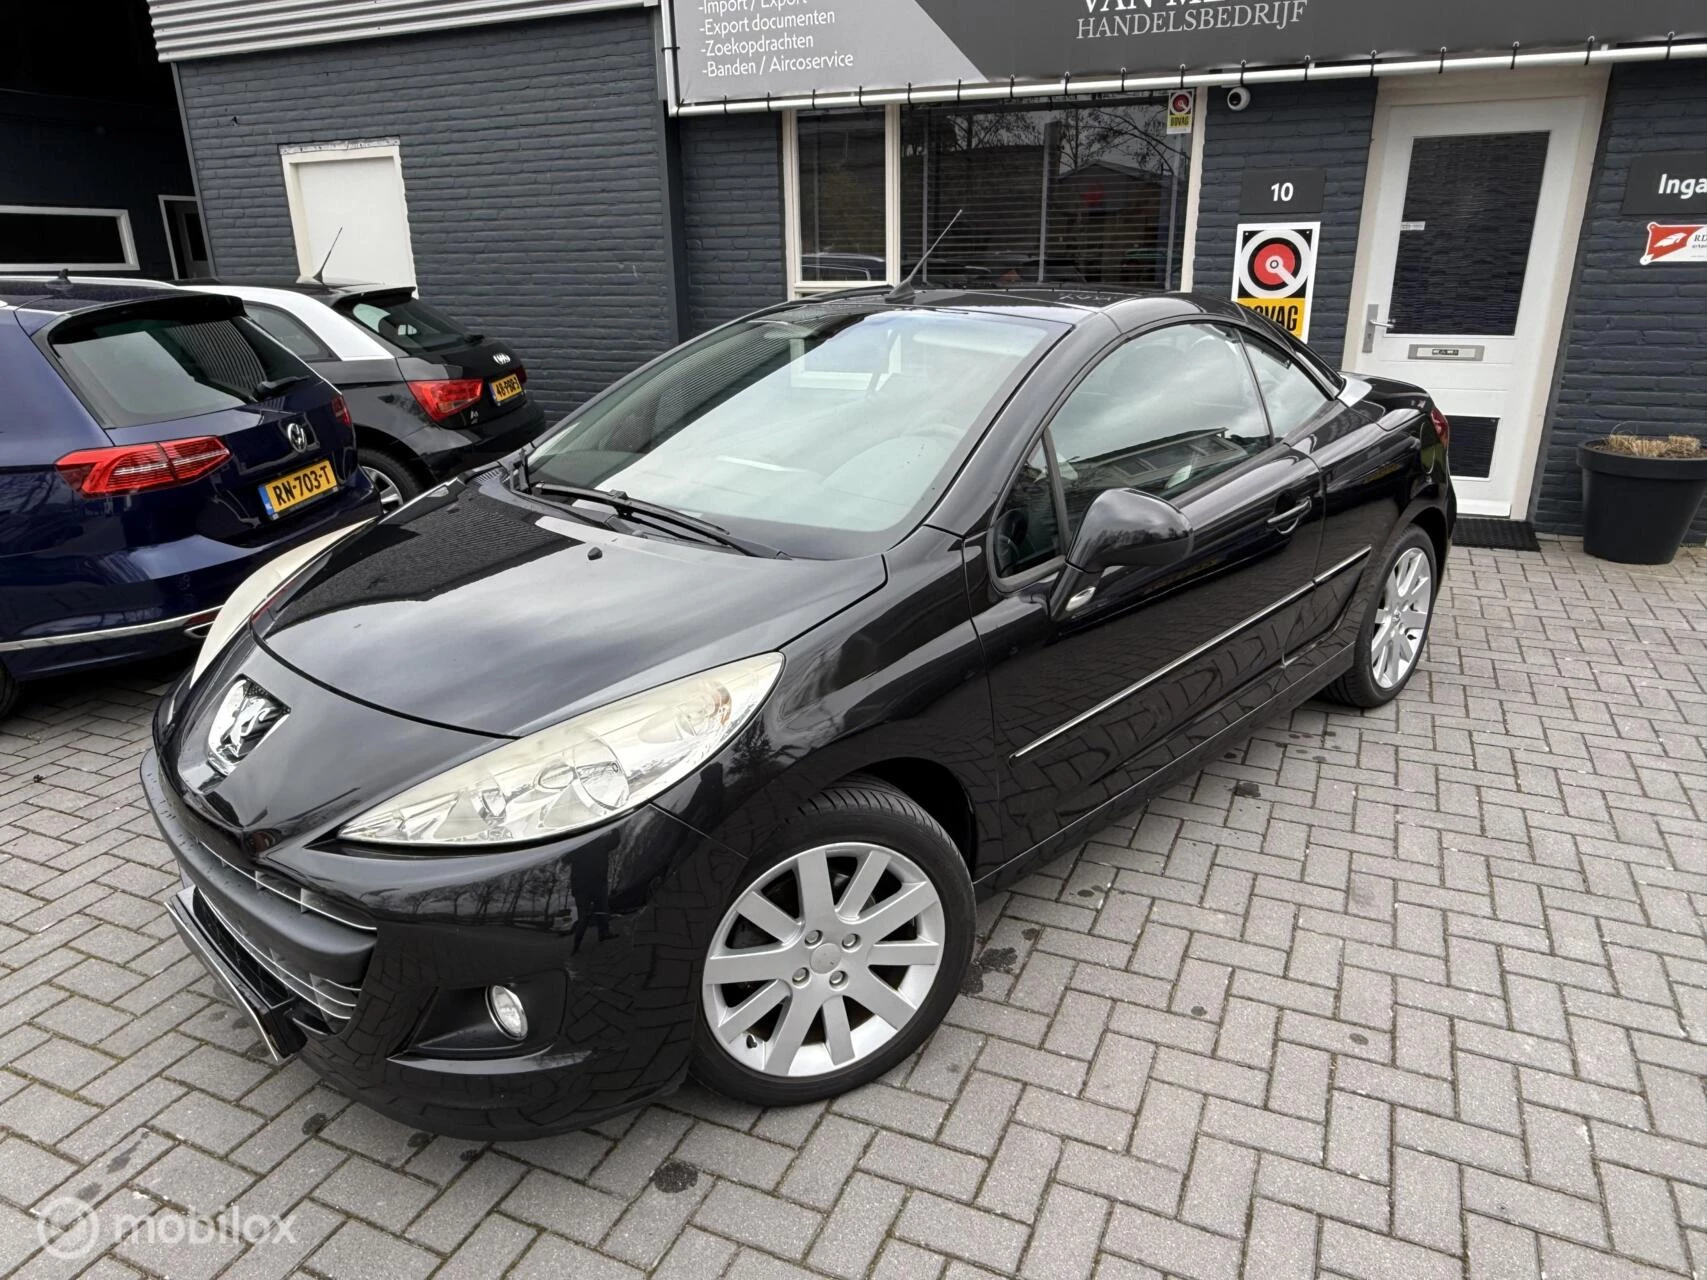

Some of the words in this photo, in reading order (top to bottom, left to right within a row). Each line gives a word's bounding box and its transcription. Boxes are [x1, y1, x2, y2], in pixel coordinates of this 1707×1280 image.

[761, 0, 807, 11] Expo
[699, 17, 750, 38] -Export
[752, 11, 834, 31] documenten
[1076, 0, 1308, 39] HANDELSBEDRIJF
[700, 32, 814, 57] -Zoekopdrachten
[702, 58, 756, 77] -Banden
[769, 50, 854, 73] Aircoservice
[1271, 182, 1294, 201] 10
[1247, 305, 1299, 331] VAG
[272, 465, 331, 506] RN-703-T
